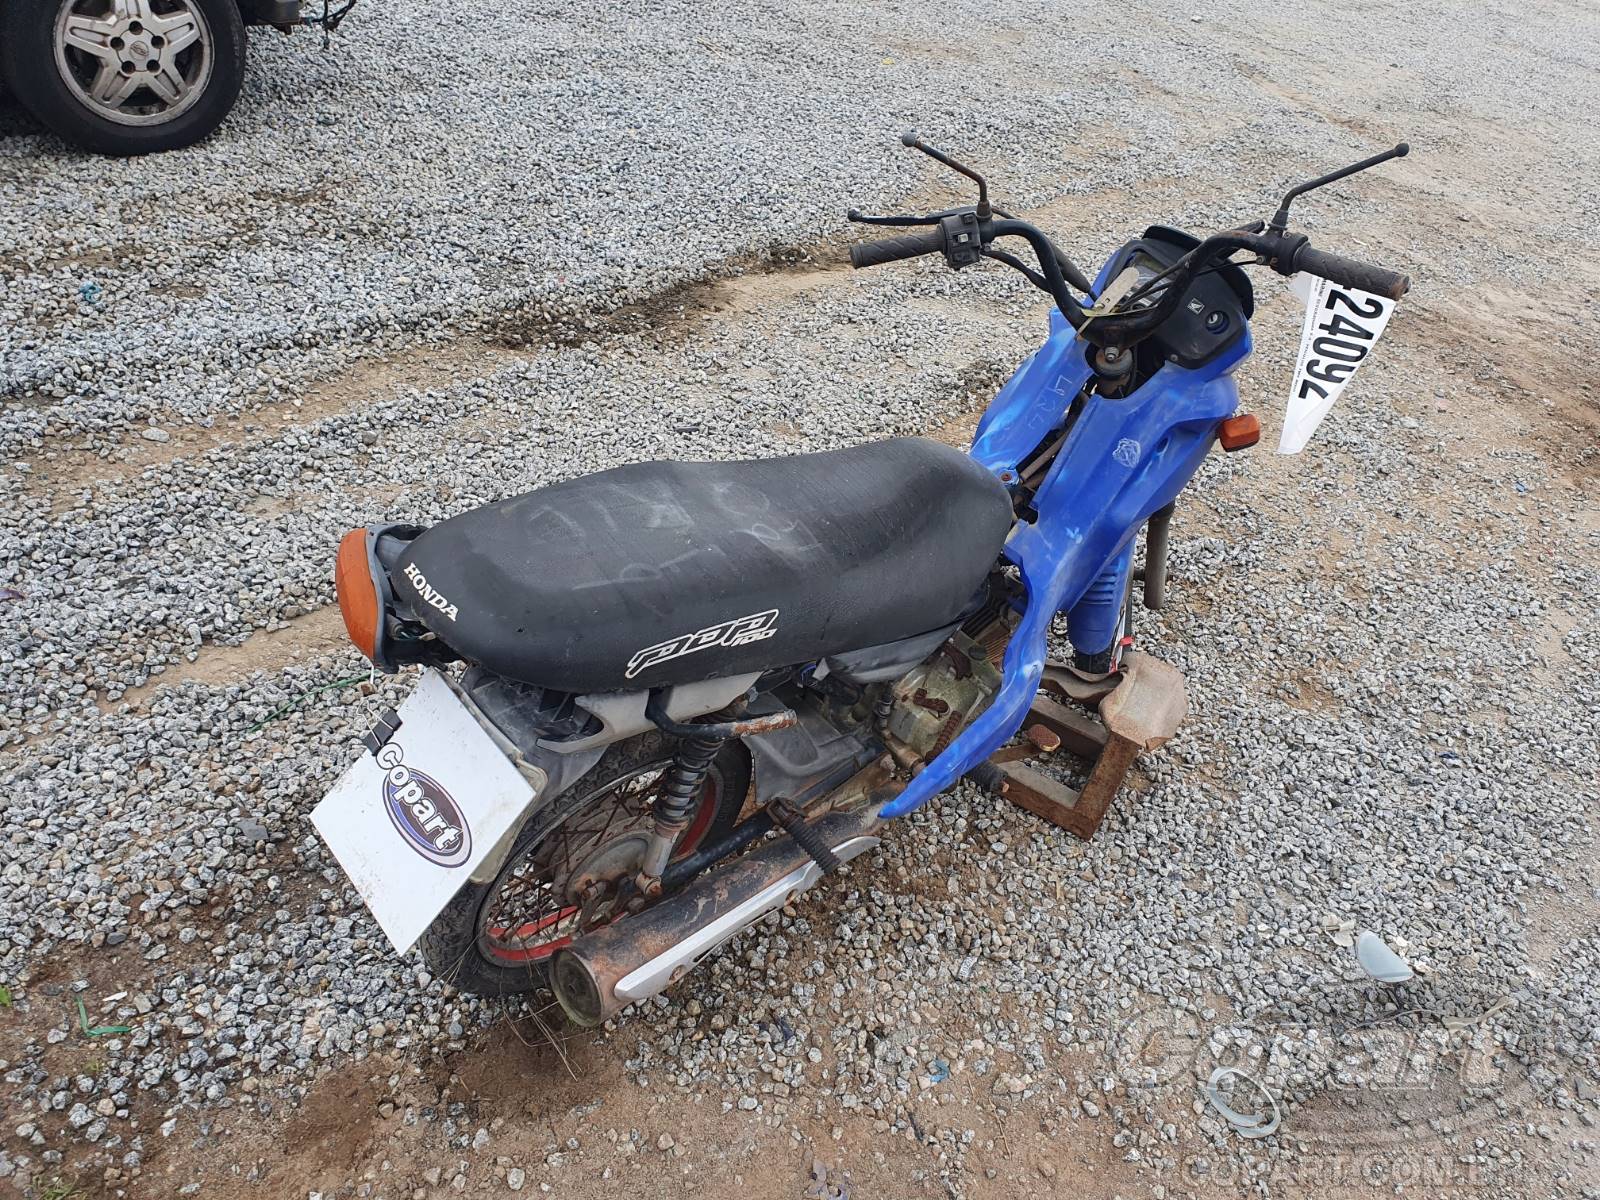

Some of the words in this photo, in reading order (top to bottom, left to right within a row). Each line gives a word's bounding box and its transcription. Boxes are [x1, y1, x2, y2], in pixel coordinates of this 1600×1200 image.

[1299, 286, 1384, 400] 24092
[404, 562, 459, 621] HONDA
[731, 628, 779, 647] 100
[376, 741, 463, 850] Copart
